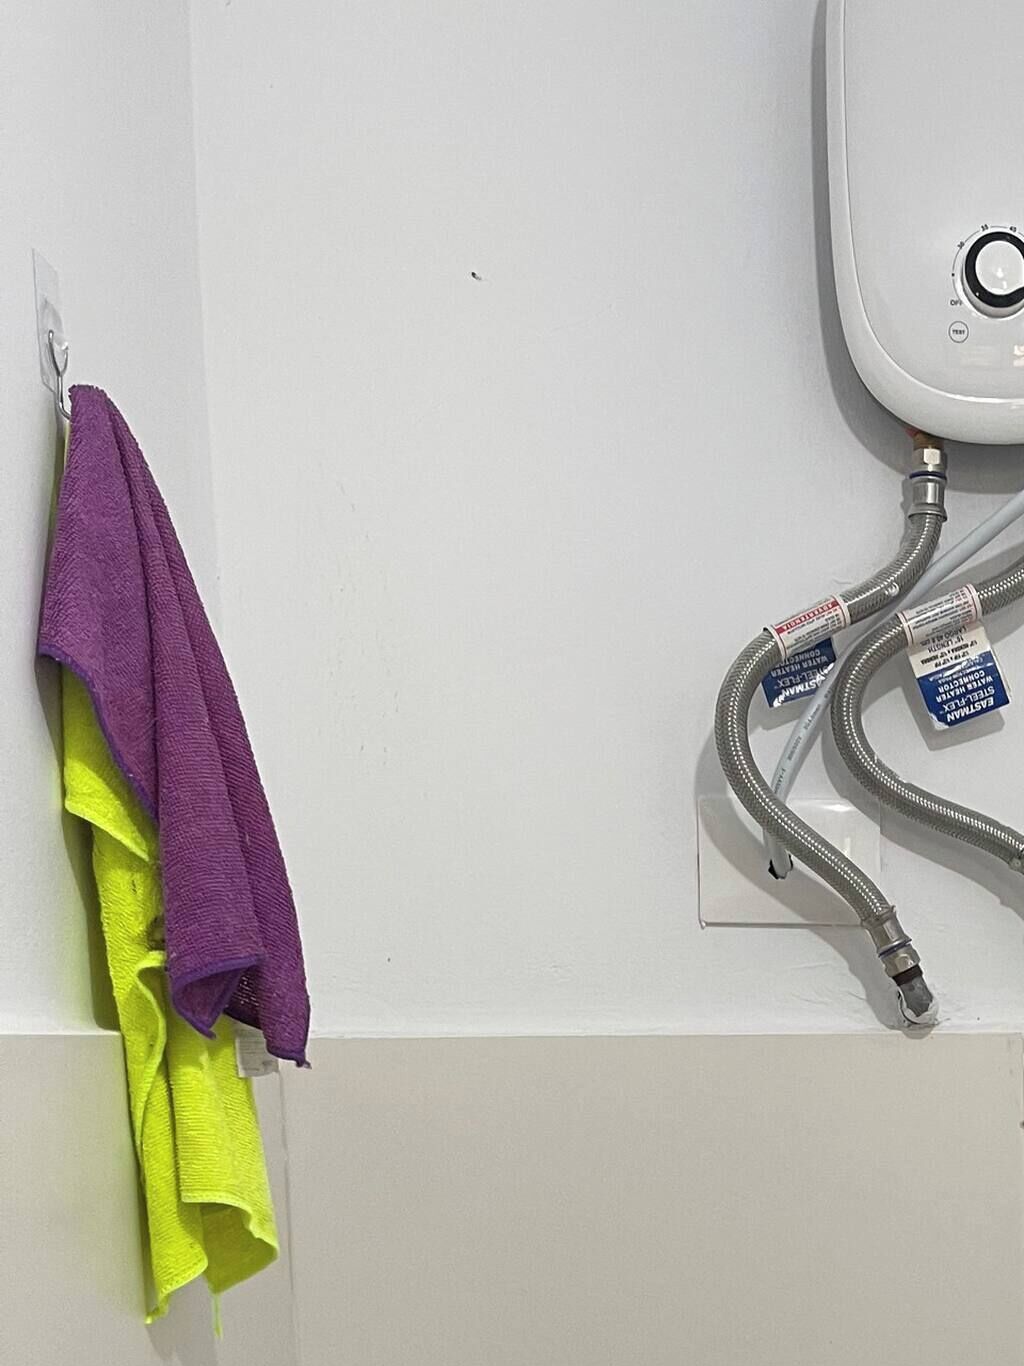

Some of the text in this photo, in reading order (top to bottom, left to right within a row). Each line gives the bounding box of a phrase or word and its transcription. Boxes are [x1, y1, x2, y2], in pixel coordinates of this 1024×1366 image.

[934, 674, 993, 703] WATER HEATER
[937, 669, 985, 693] CONNECTOR
[945, 696, 995, 722] EASTMAN
